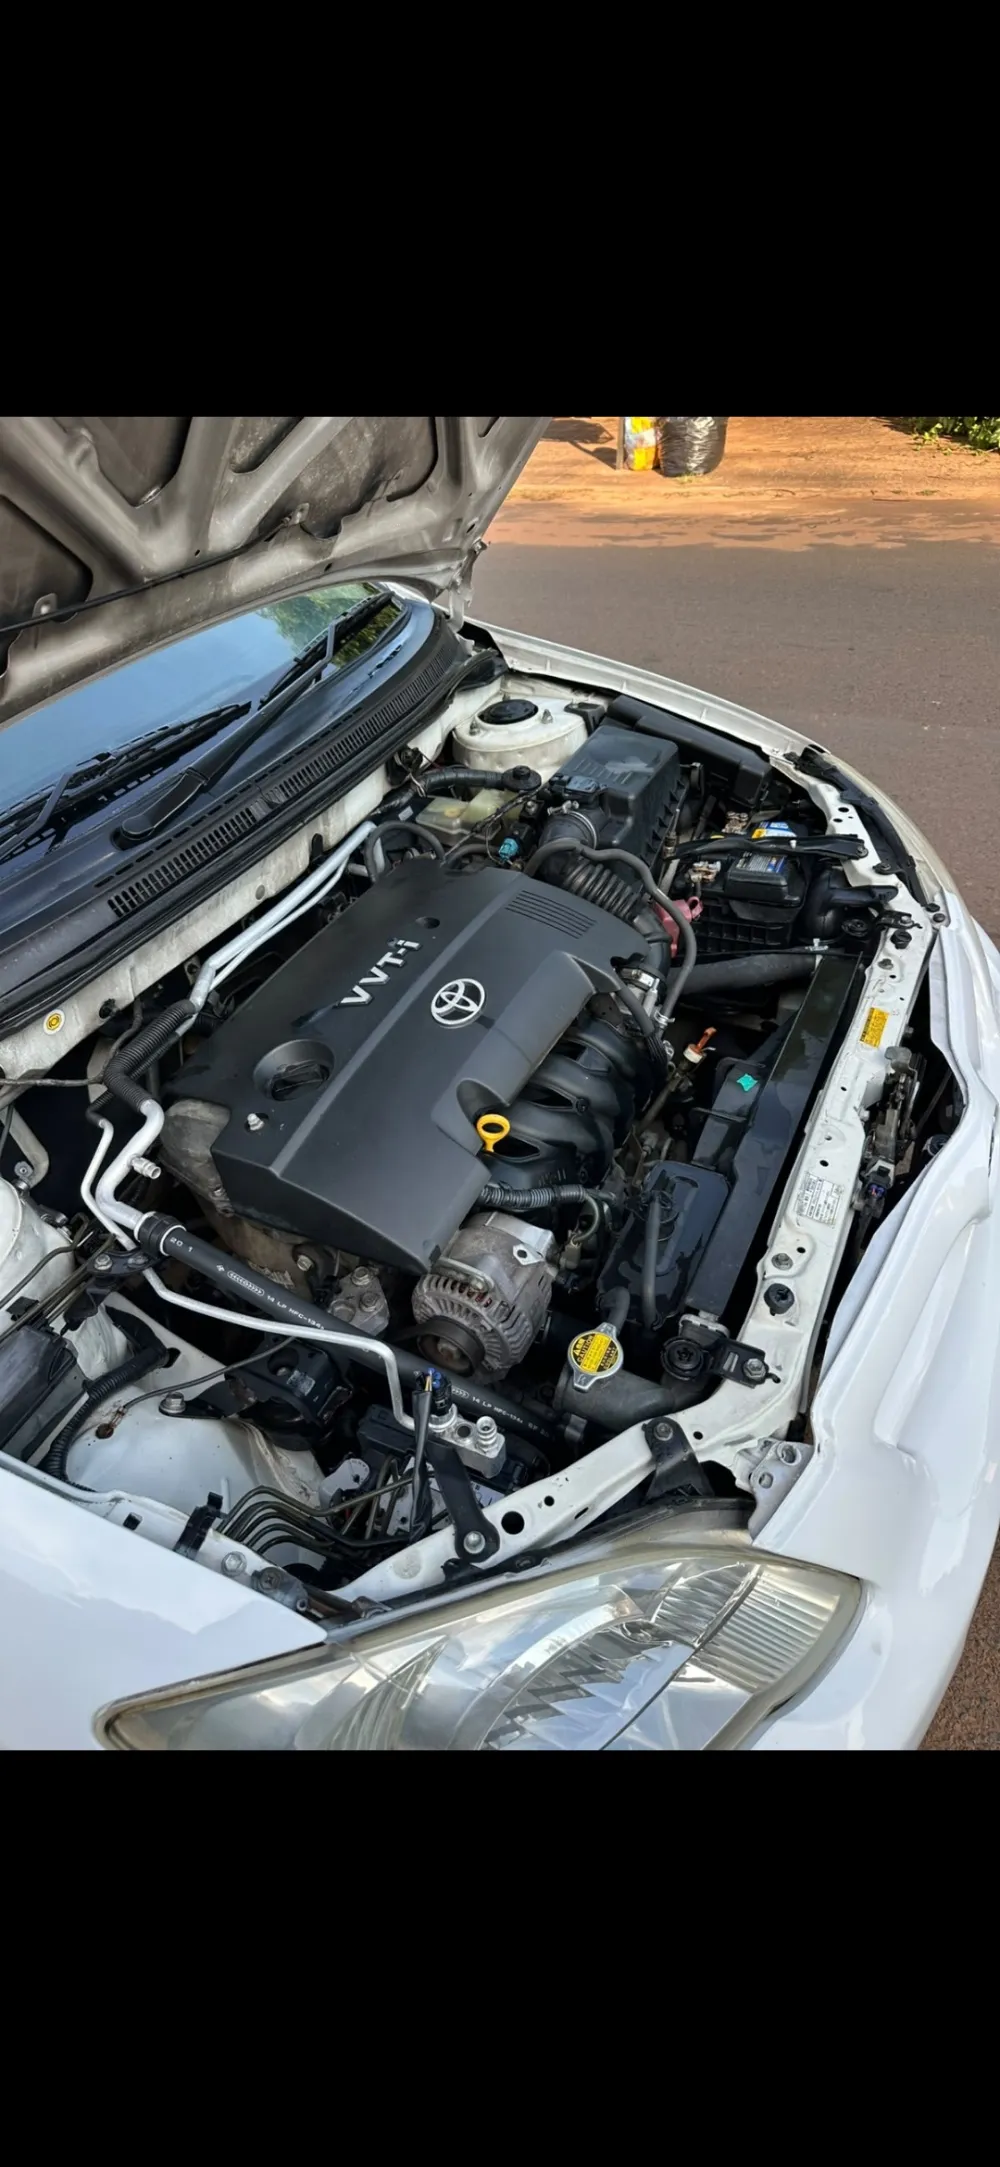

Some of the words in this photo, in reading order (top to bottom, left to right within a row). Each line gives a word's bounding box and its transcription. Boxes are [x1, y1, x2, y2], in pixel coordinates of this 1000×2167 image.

[341, 939, 420, 1004] VVT-i
[169, 1236, 184, 1247] 20
[576, 1334, 593, 1363] CAUTION
